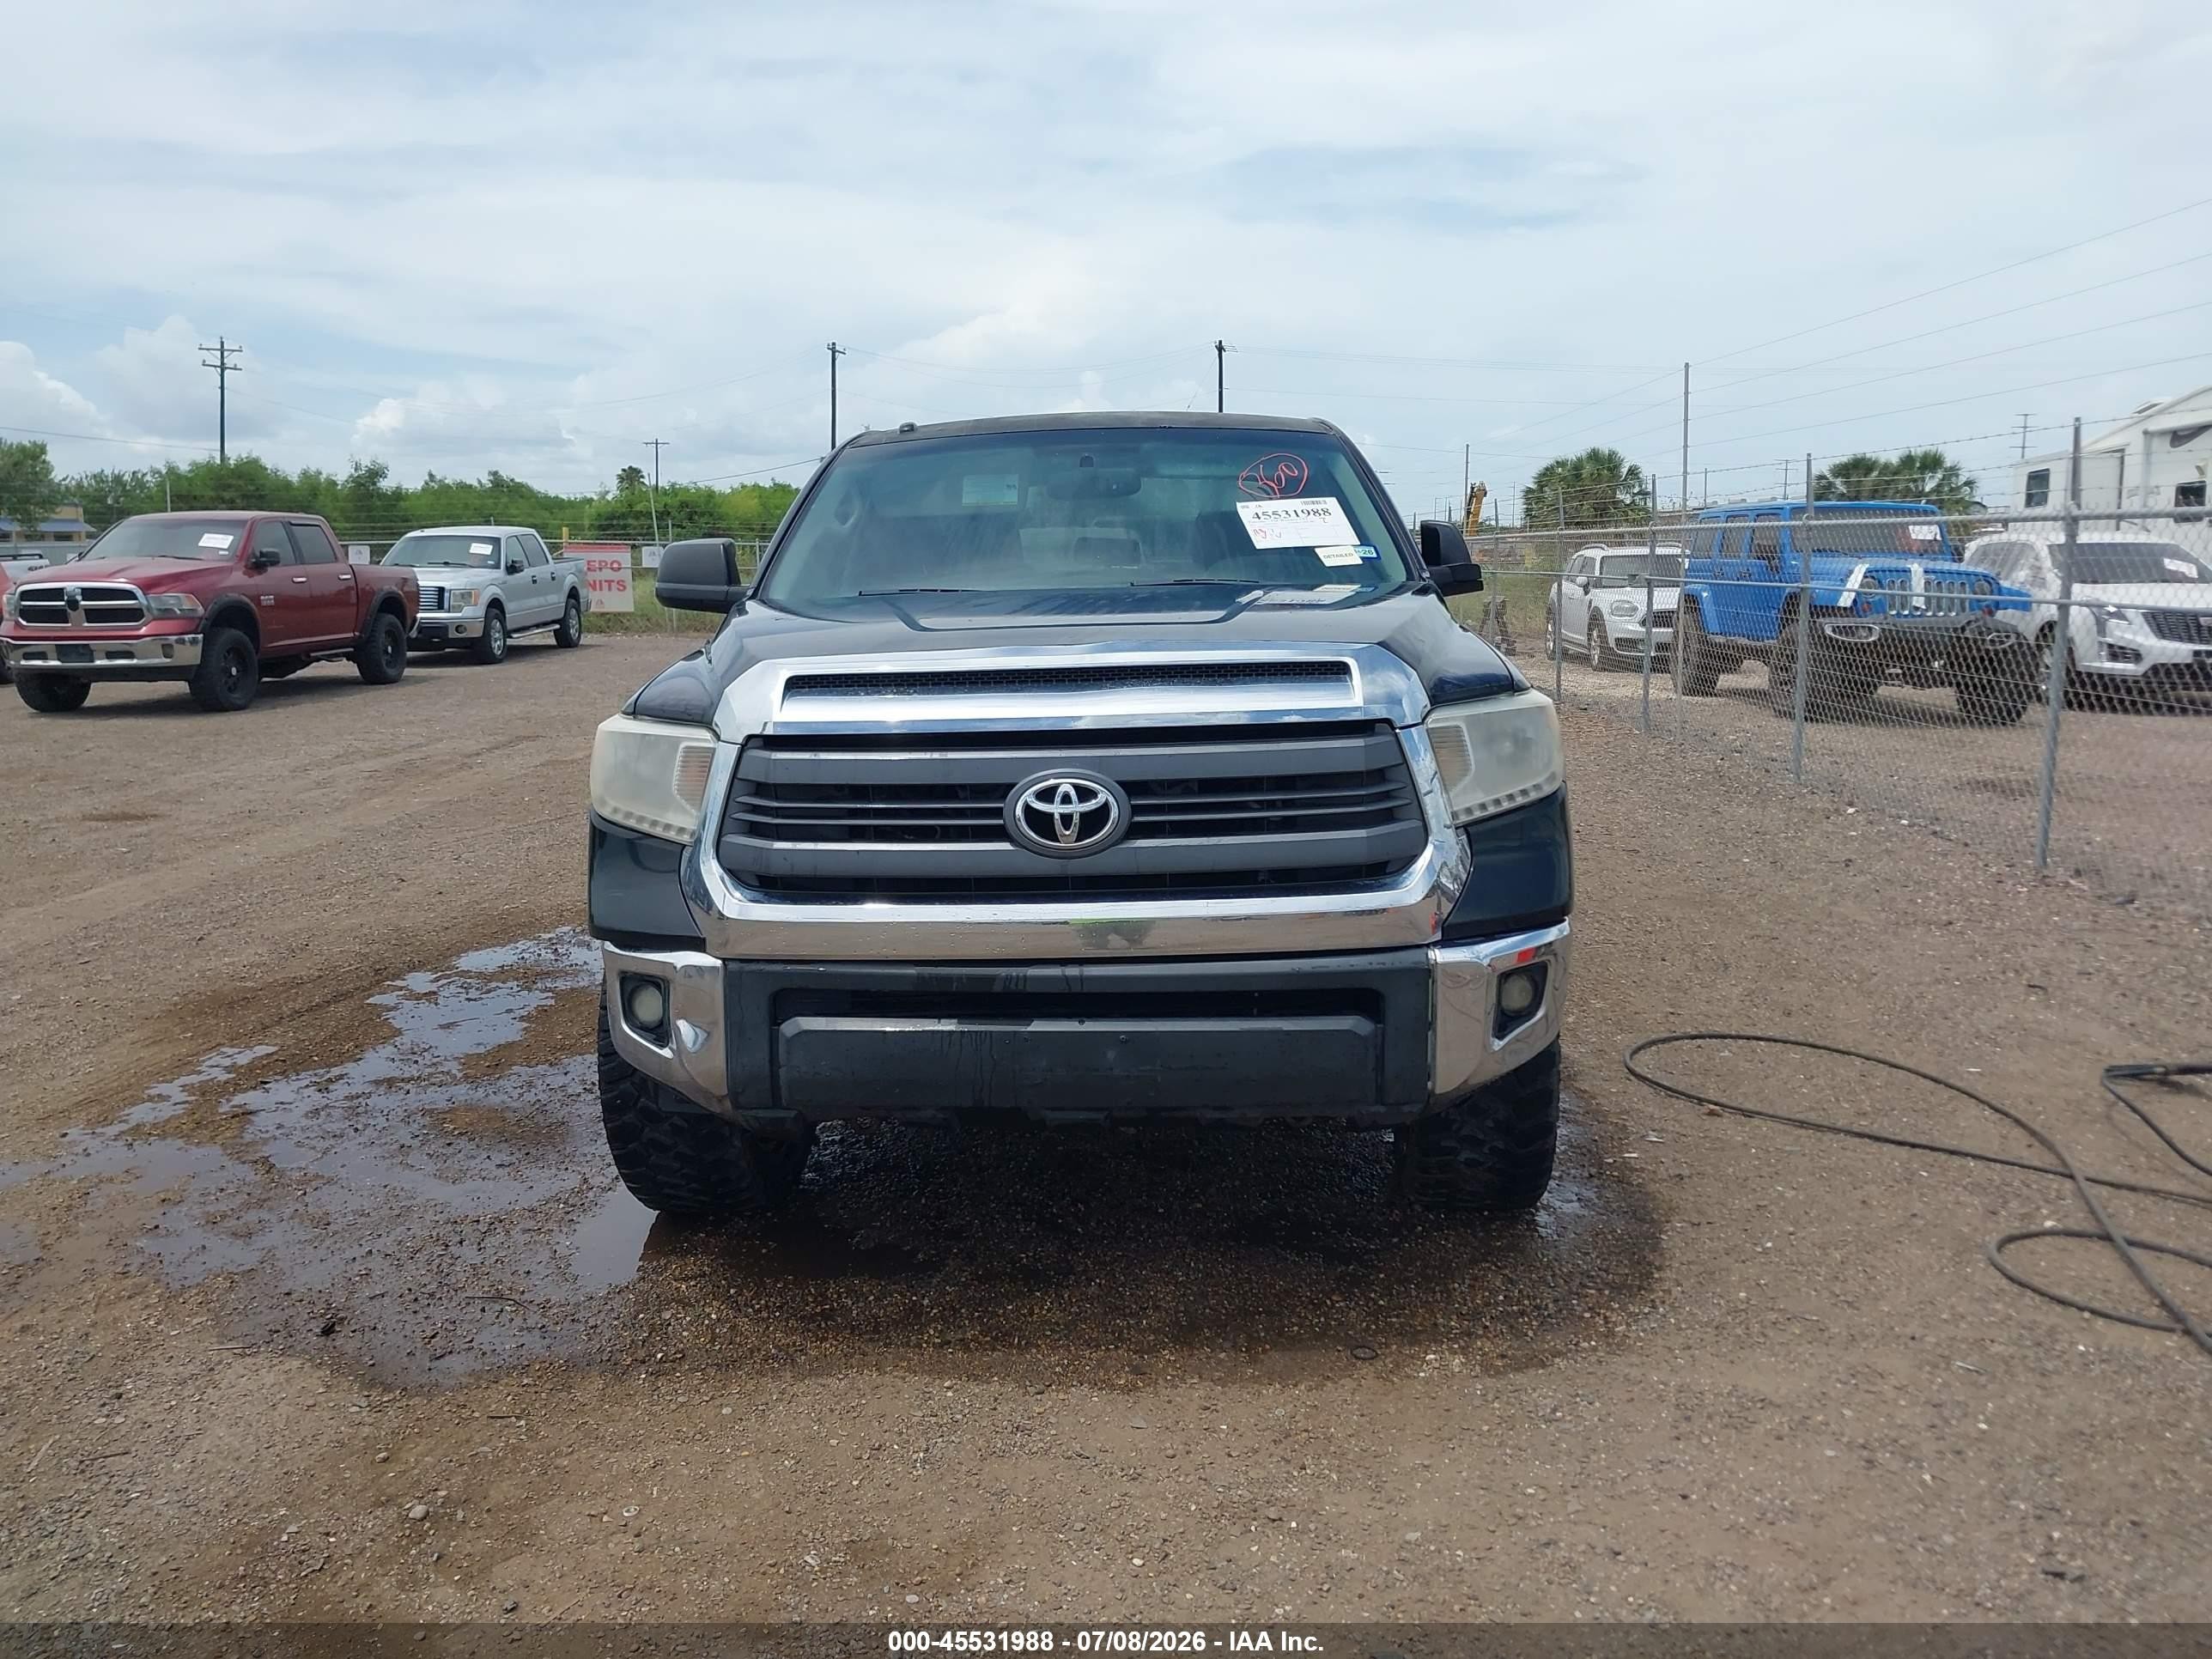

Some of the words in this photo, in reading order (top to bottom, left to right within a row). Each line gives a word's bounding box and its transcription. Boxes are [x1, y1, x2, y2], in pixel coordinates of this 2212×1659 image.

[1252, 507, 1332, 520] 45531988
[586, 560, 623, 573] EPO
[587, 579, 627, 592] NITS
